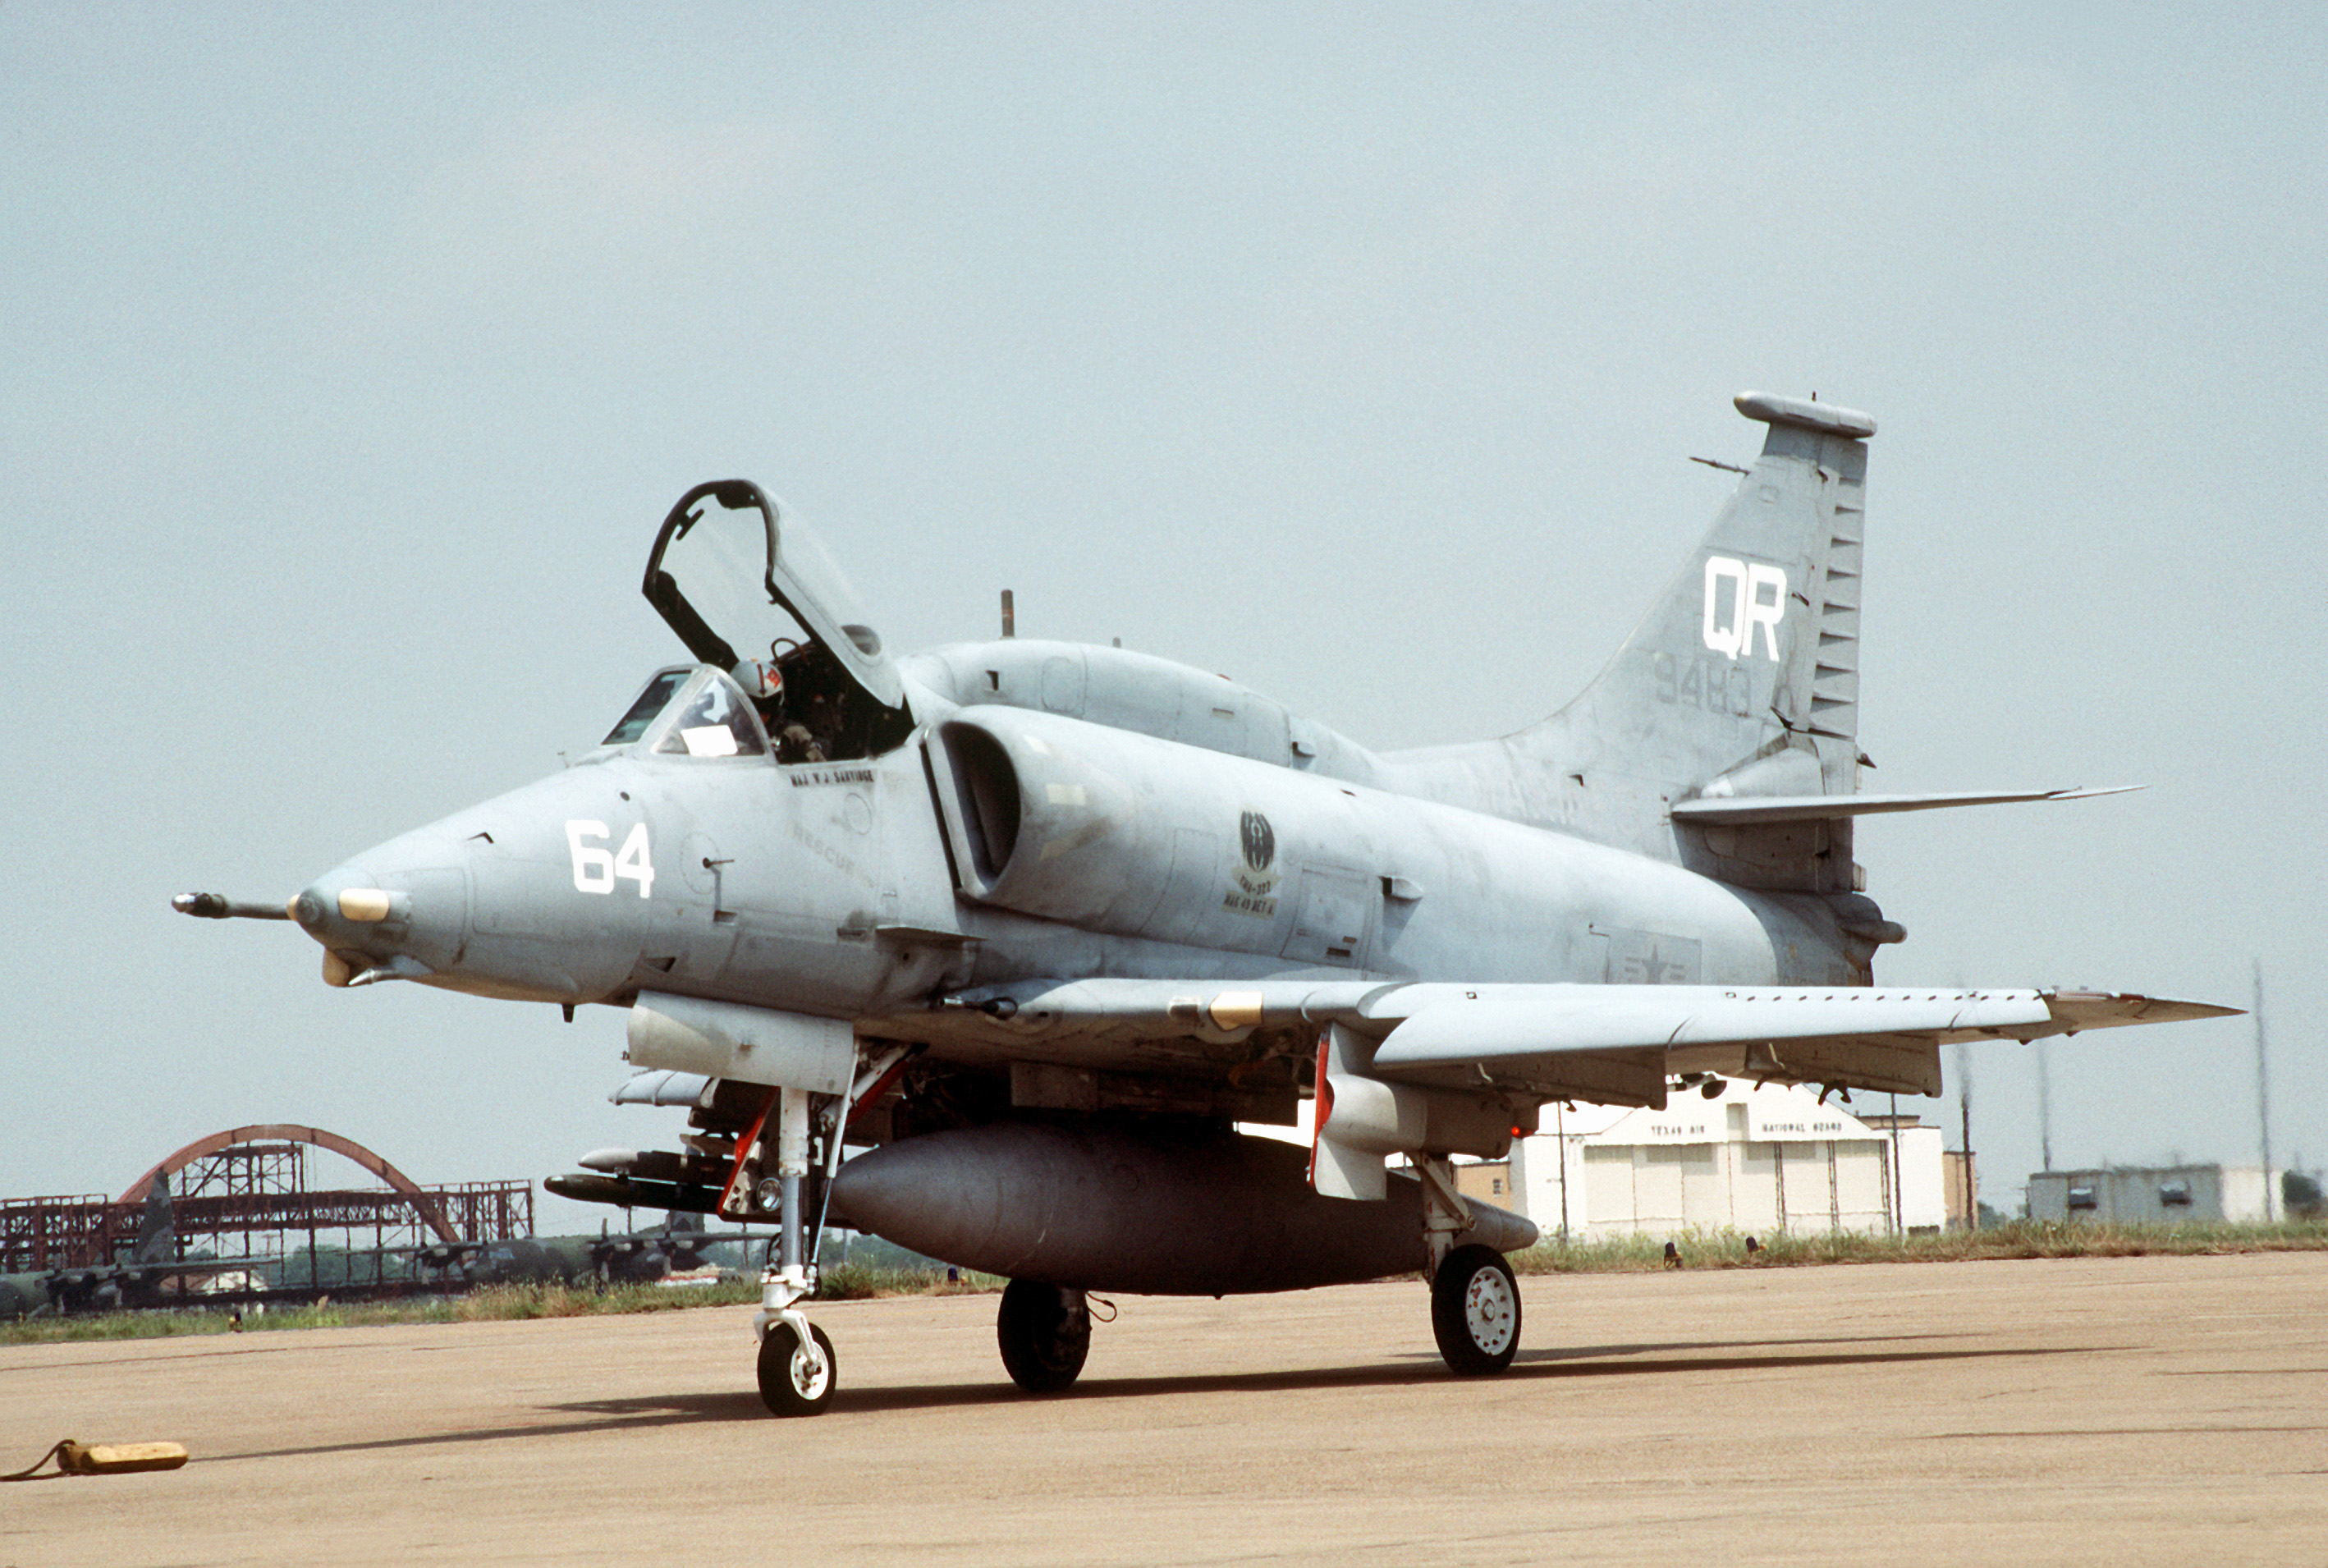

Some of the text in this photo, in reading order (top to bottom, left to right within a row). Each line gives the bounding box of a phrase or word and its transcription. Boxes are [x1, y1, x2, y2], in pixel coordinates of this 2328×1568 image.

[1703, 556, 1787, 662] QR
[565, 819, 654, 898] 64
[1651, 1125, 1682, 1135] TEXAS
[1689, 1125, 1705, 1134] AIR
[1762, 1122, 1805, 1133] NATIONAL
